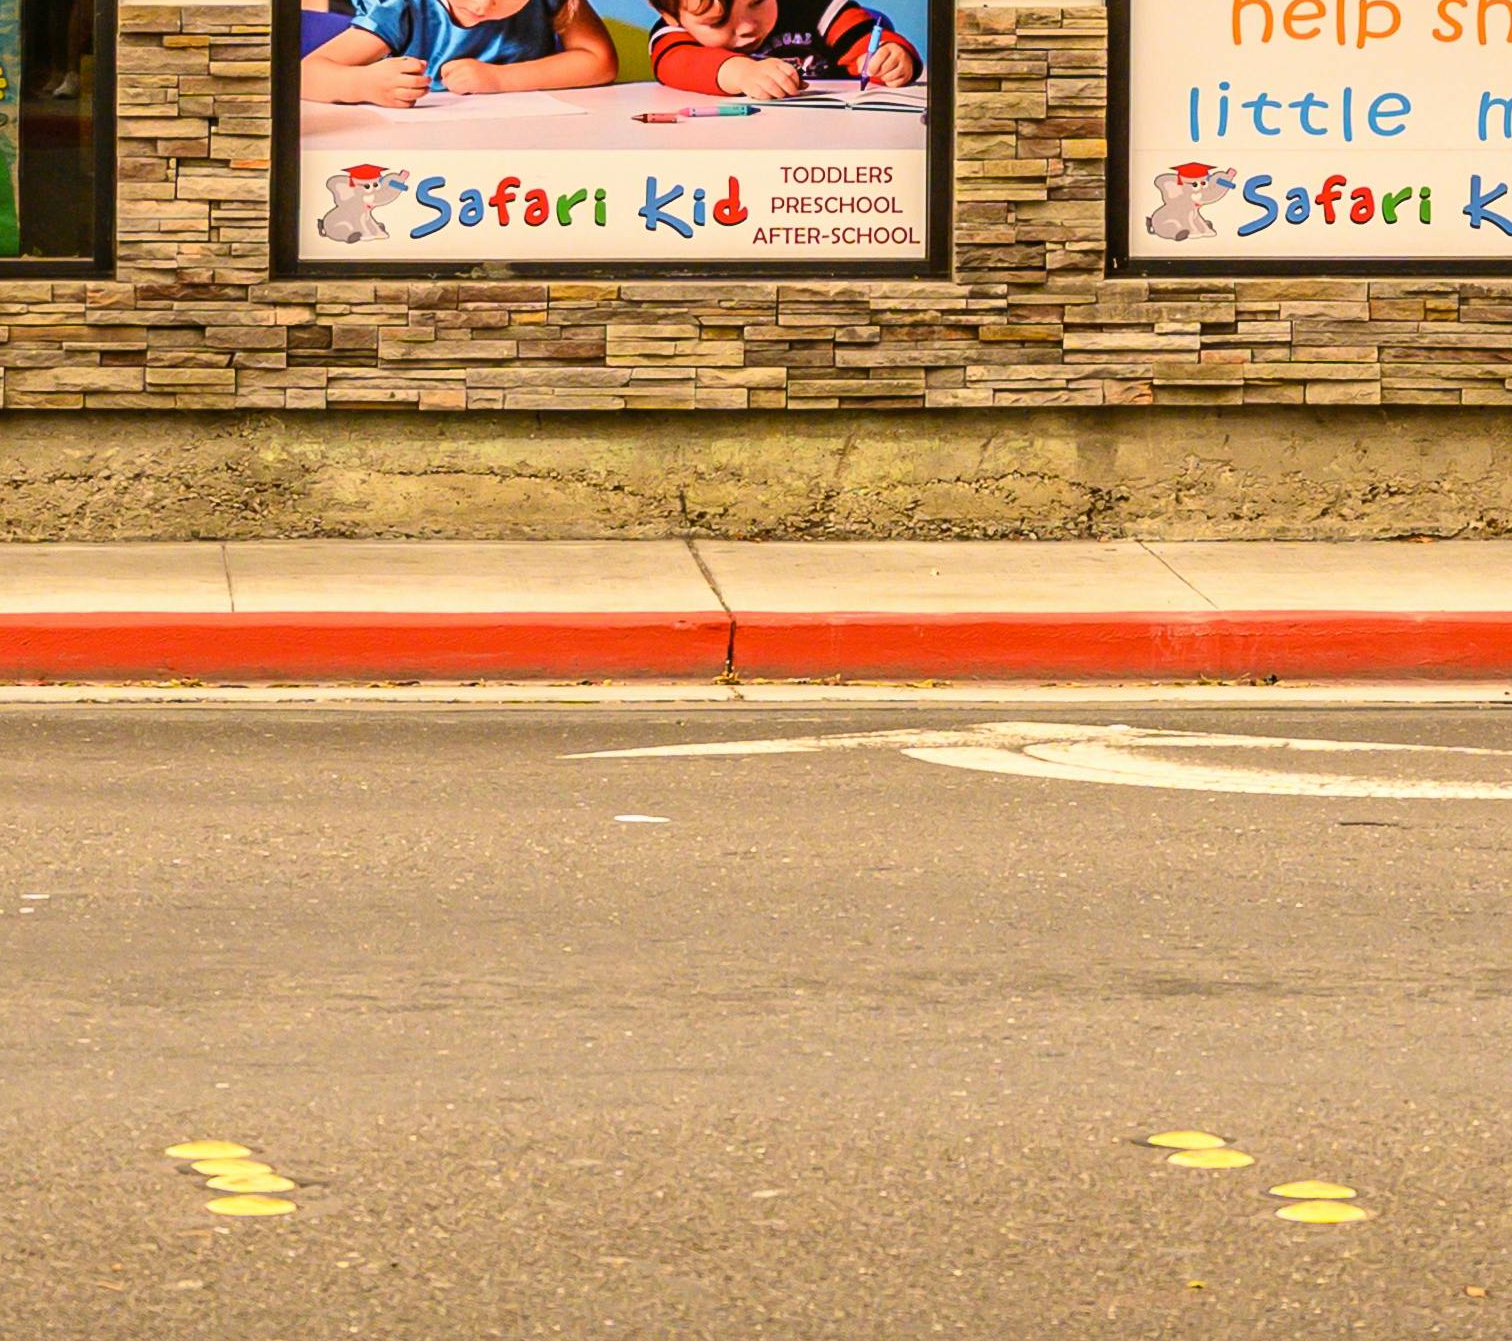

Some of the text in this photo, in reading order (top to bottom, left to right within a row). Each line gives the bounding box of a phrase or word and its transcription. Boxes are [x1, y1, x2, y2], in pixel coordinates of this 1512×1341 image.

[1189, 81, 1412, 142] little
[780, 165, 893, 183] TODDLERS
[410, 175, 748, 239] Safari Kid
[771, 196, 903, 214] PRESCHOOL
[1236, 174, 1433, 238] Safari
[753, 227, 920, 245] AFTER-SCHOOL
